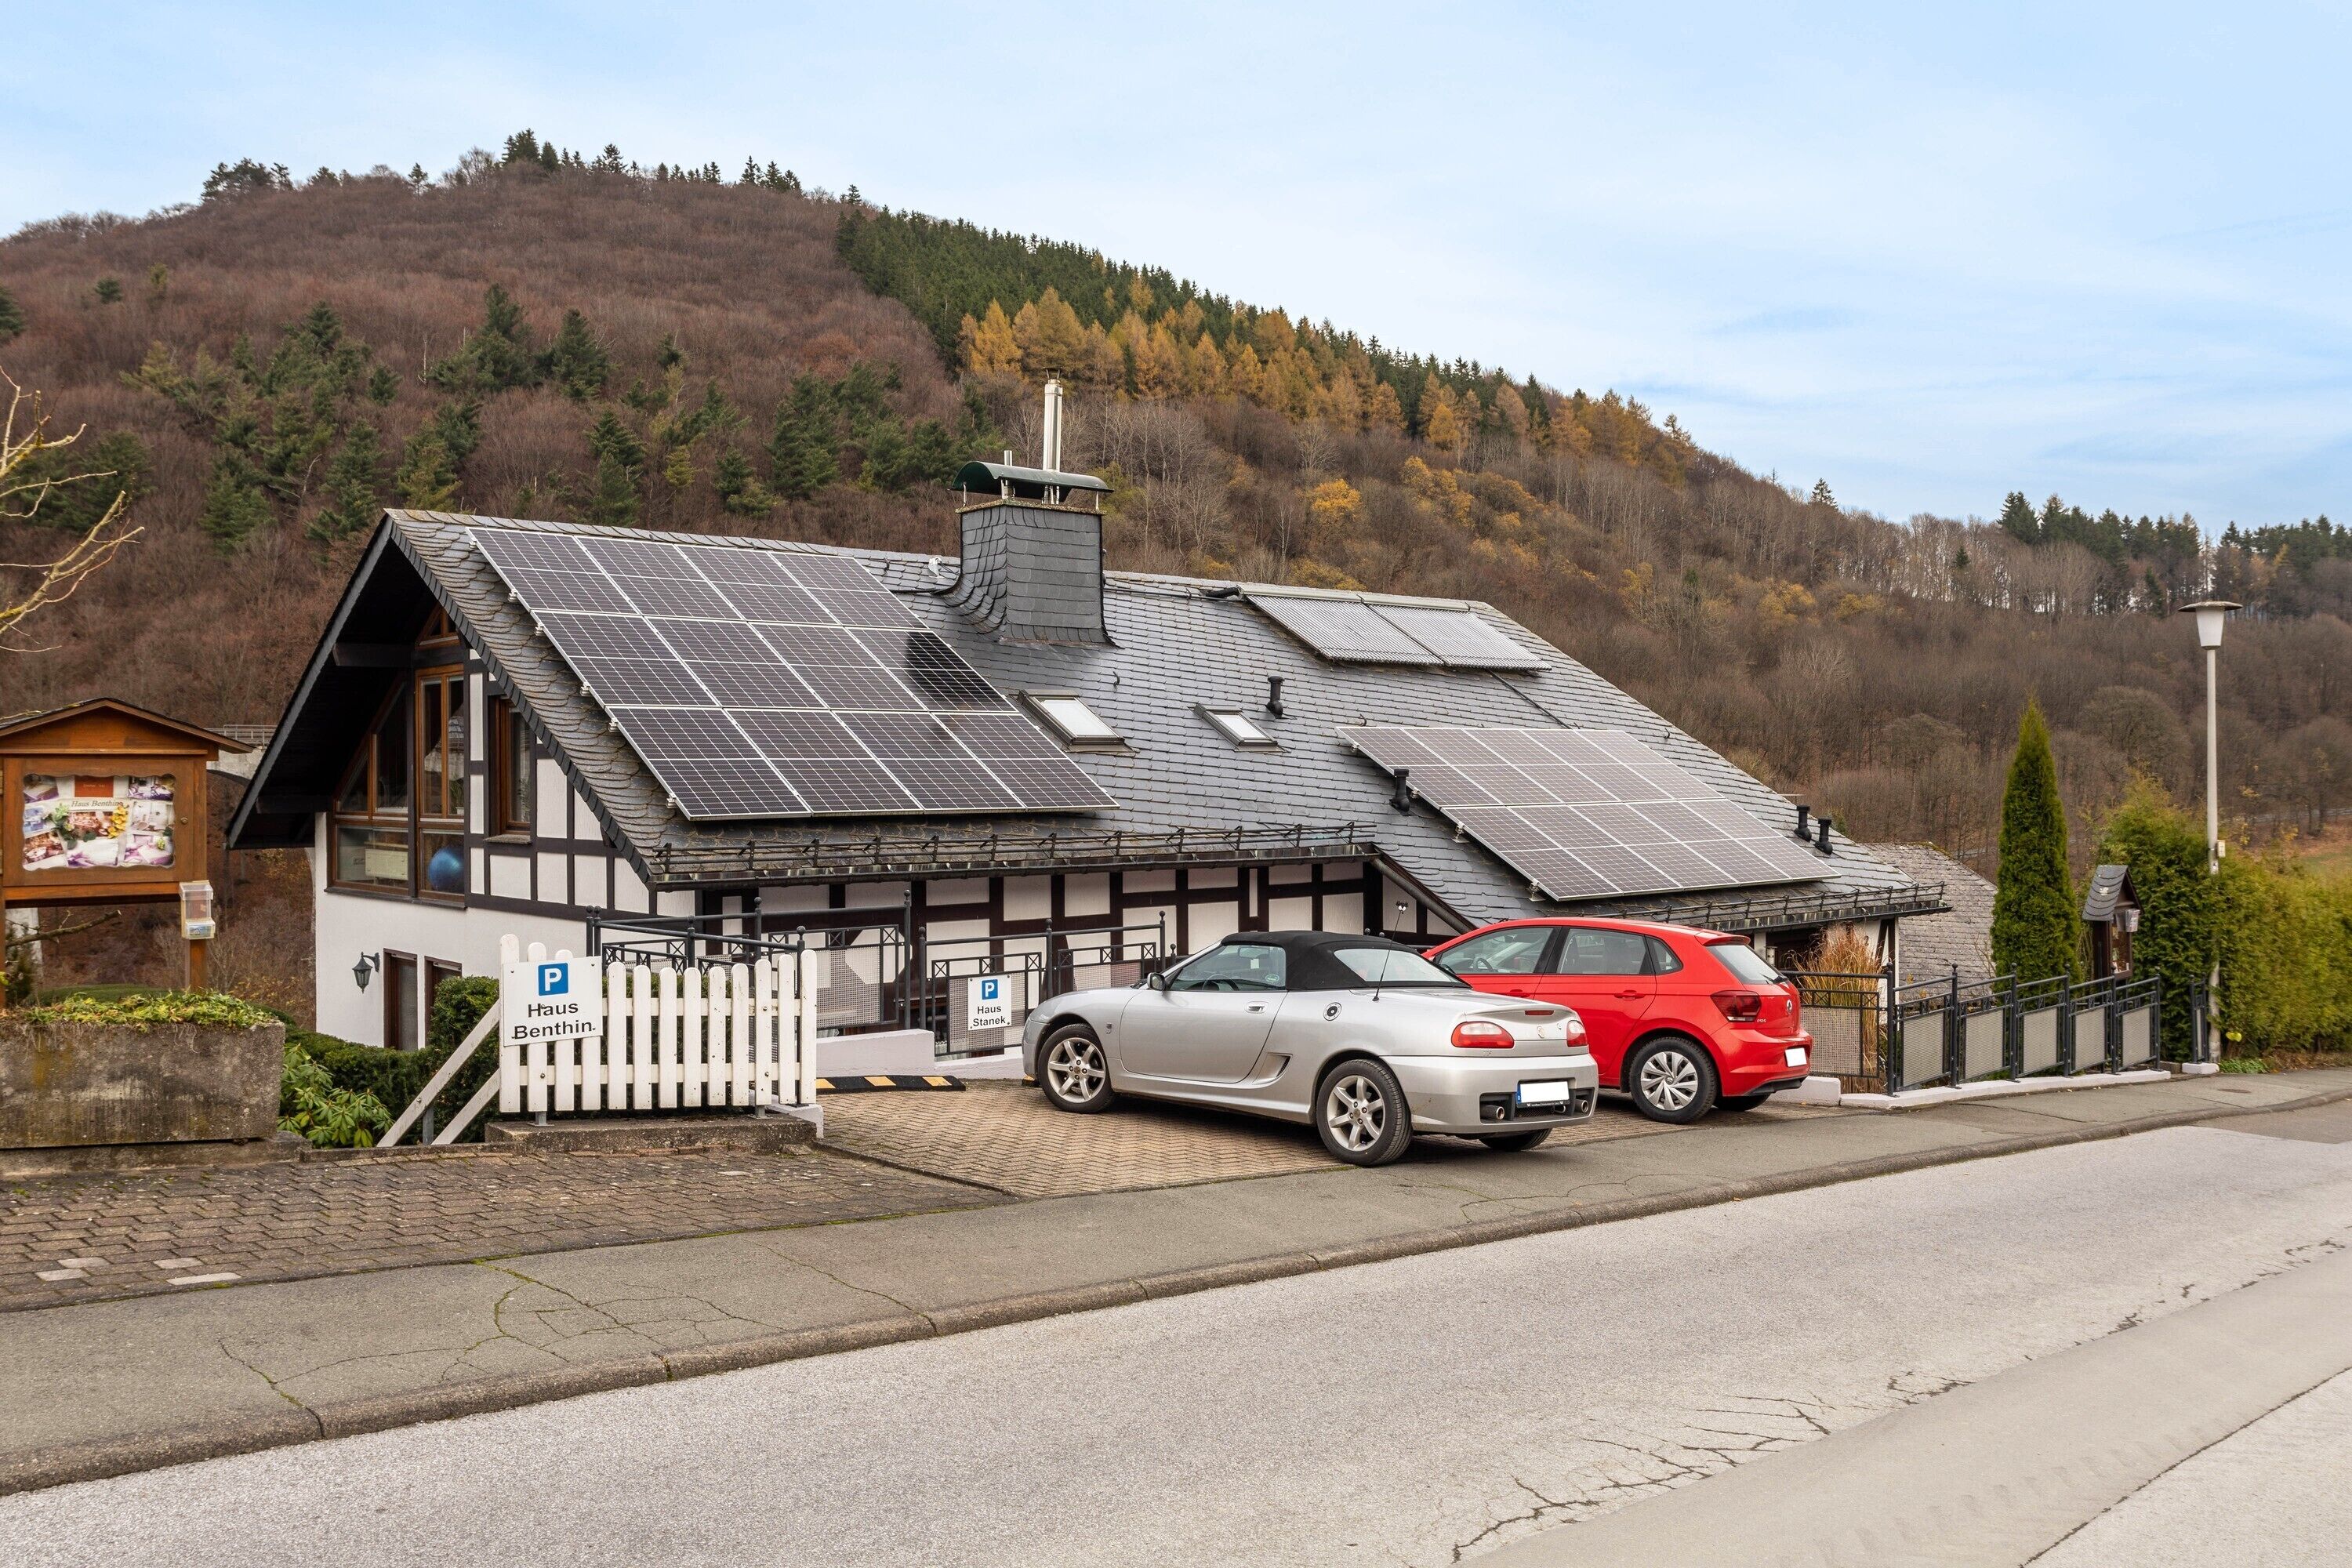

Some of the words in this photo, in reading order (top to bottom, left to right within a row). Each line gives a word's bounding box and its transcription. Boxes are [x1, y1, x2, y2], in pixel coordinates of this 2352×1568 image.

[544, 967, 562, 992] P
[985, 982, 995, 997] P
[528, 1003, 579, 1018] Haus
[977, 1006, 1002, 1014] Haus
[973, 1015, 1006, 1027] Stanek
[514, 1020, 593, 1040] Benthin
